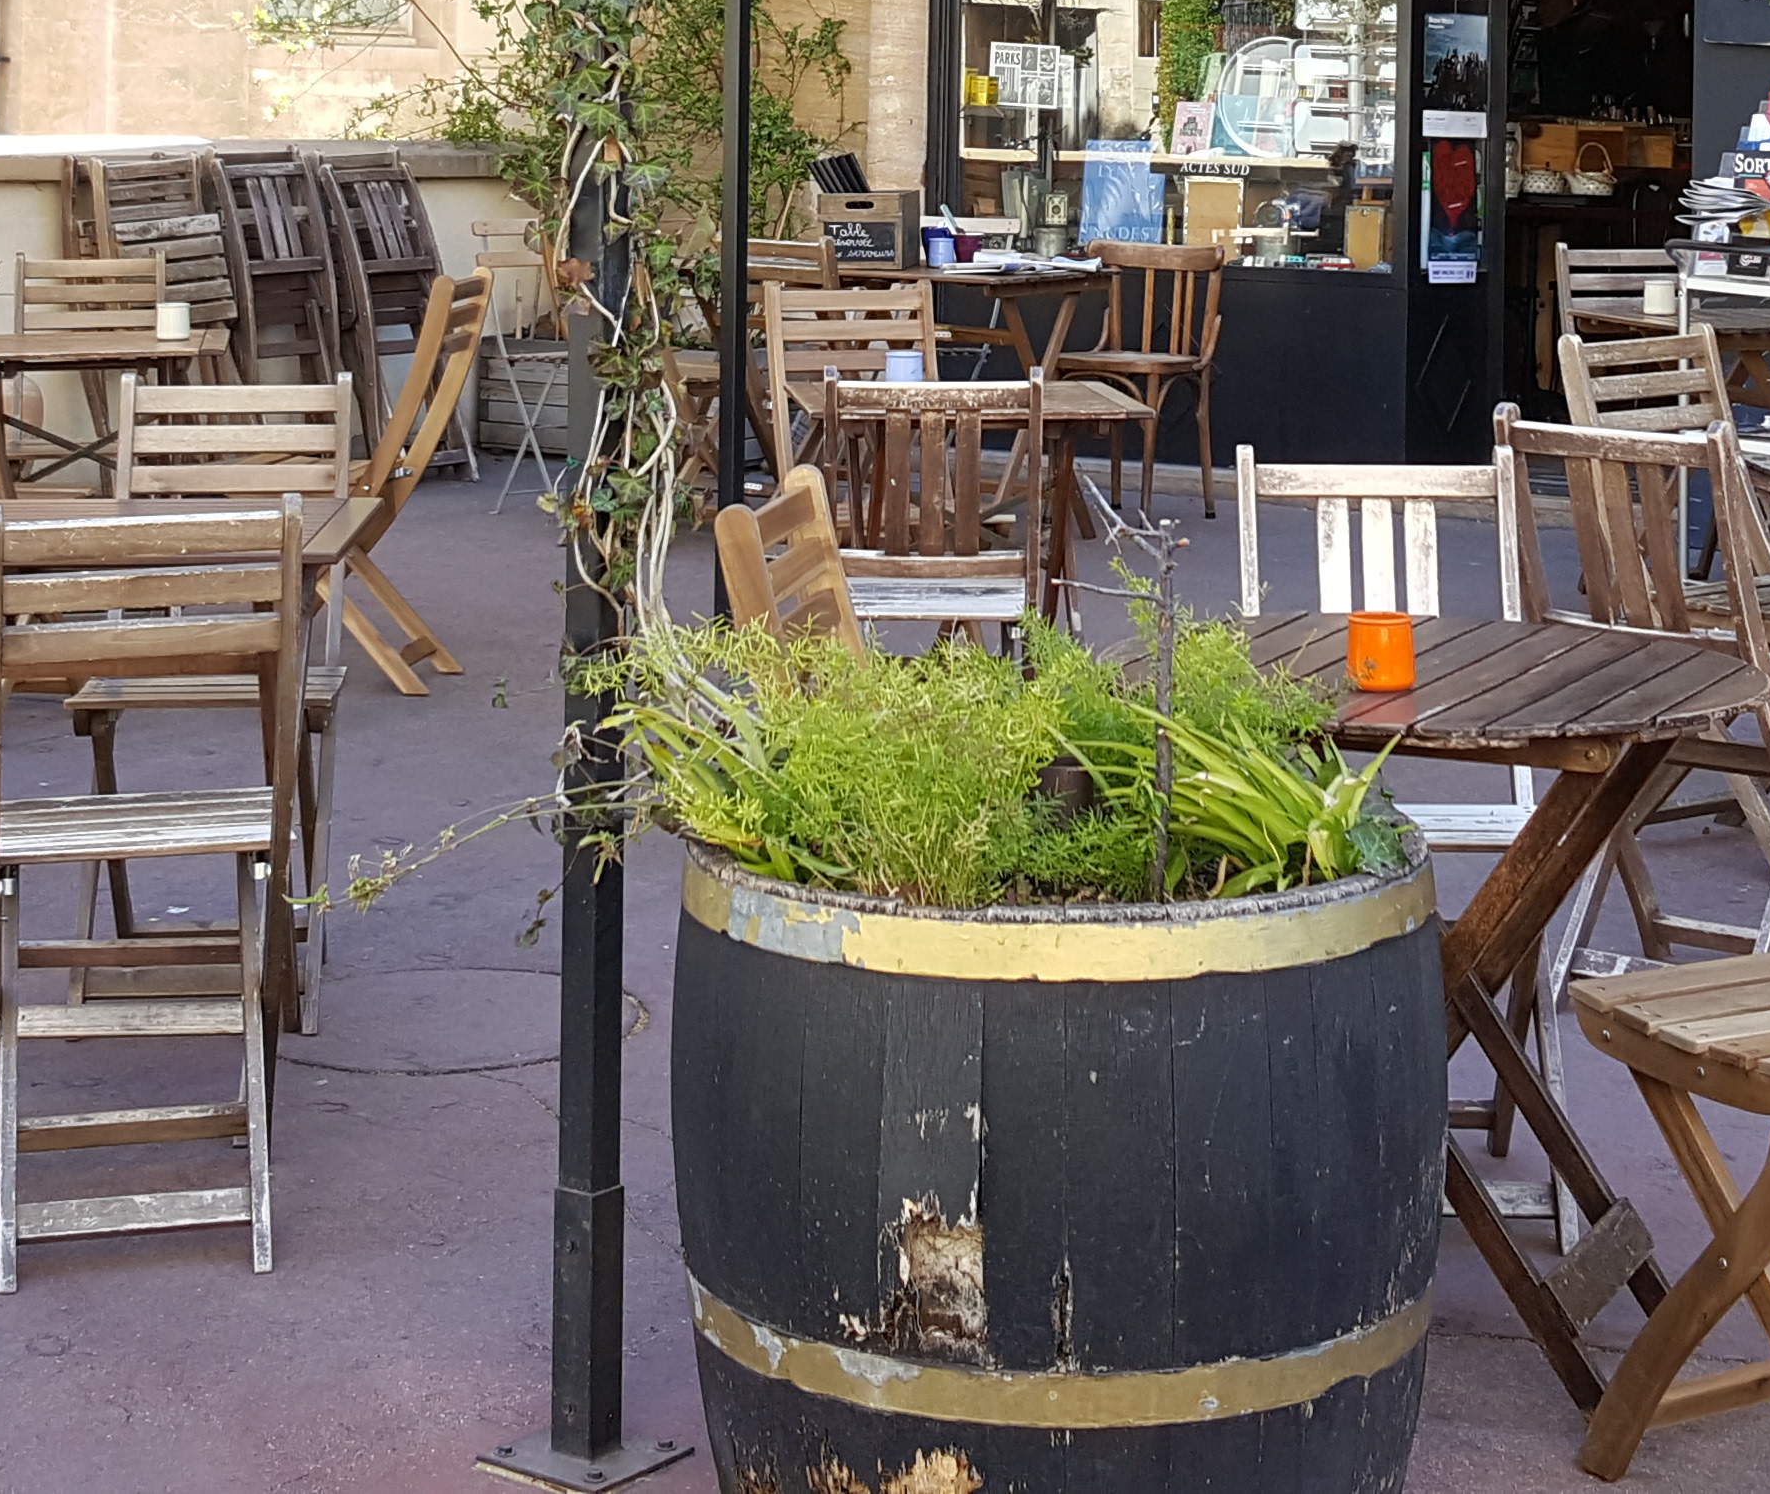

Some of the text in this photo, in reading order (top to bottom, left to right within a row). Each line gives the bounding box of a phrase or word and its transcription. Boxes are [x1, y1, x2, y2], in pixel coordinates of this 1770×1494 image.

[994, 51, 1021, 65] PARKS
[1179, 161, 1251, 177] ACTES SUD
[828, 223, 870, 239] Table
